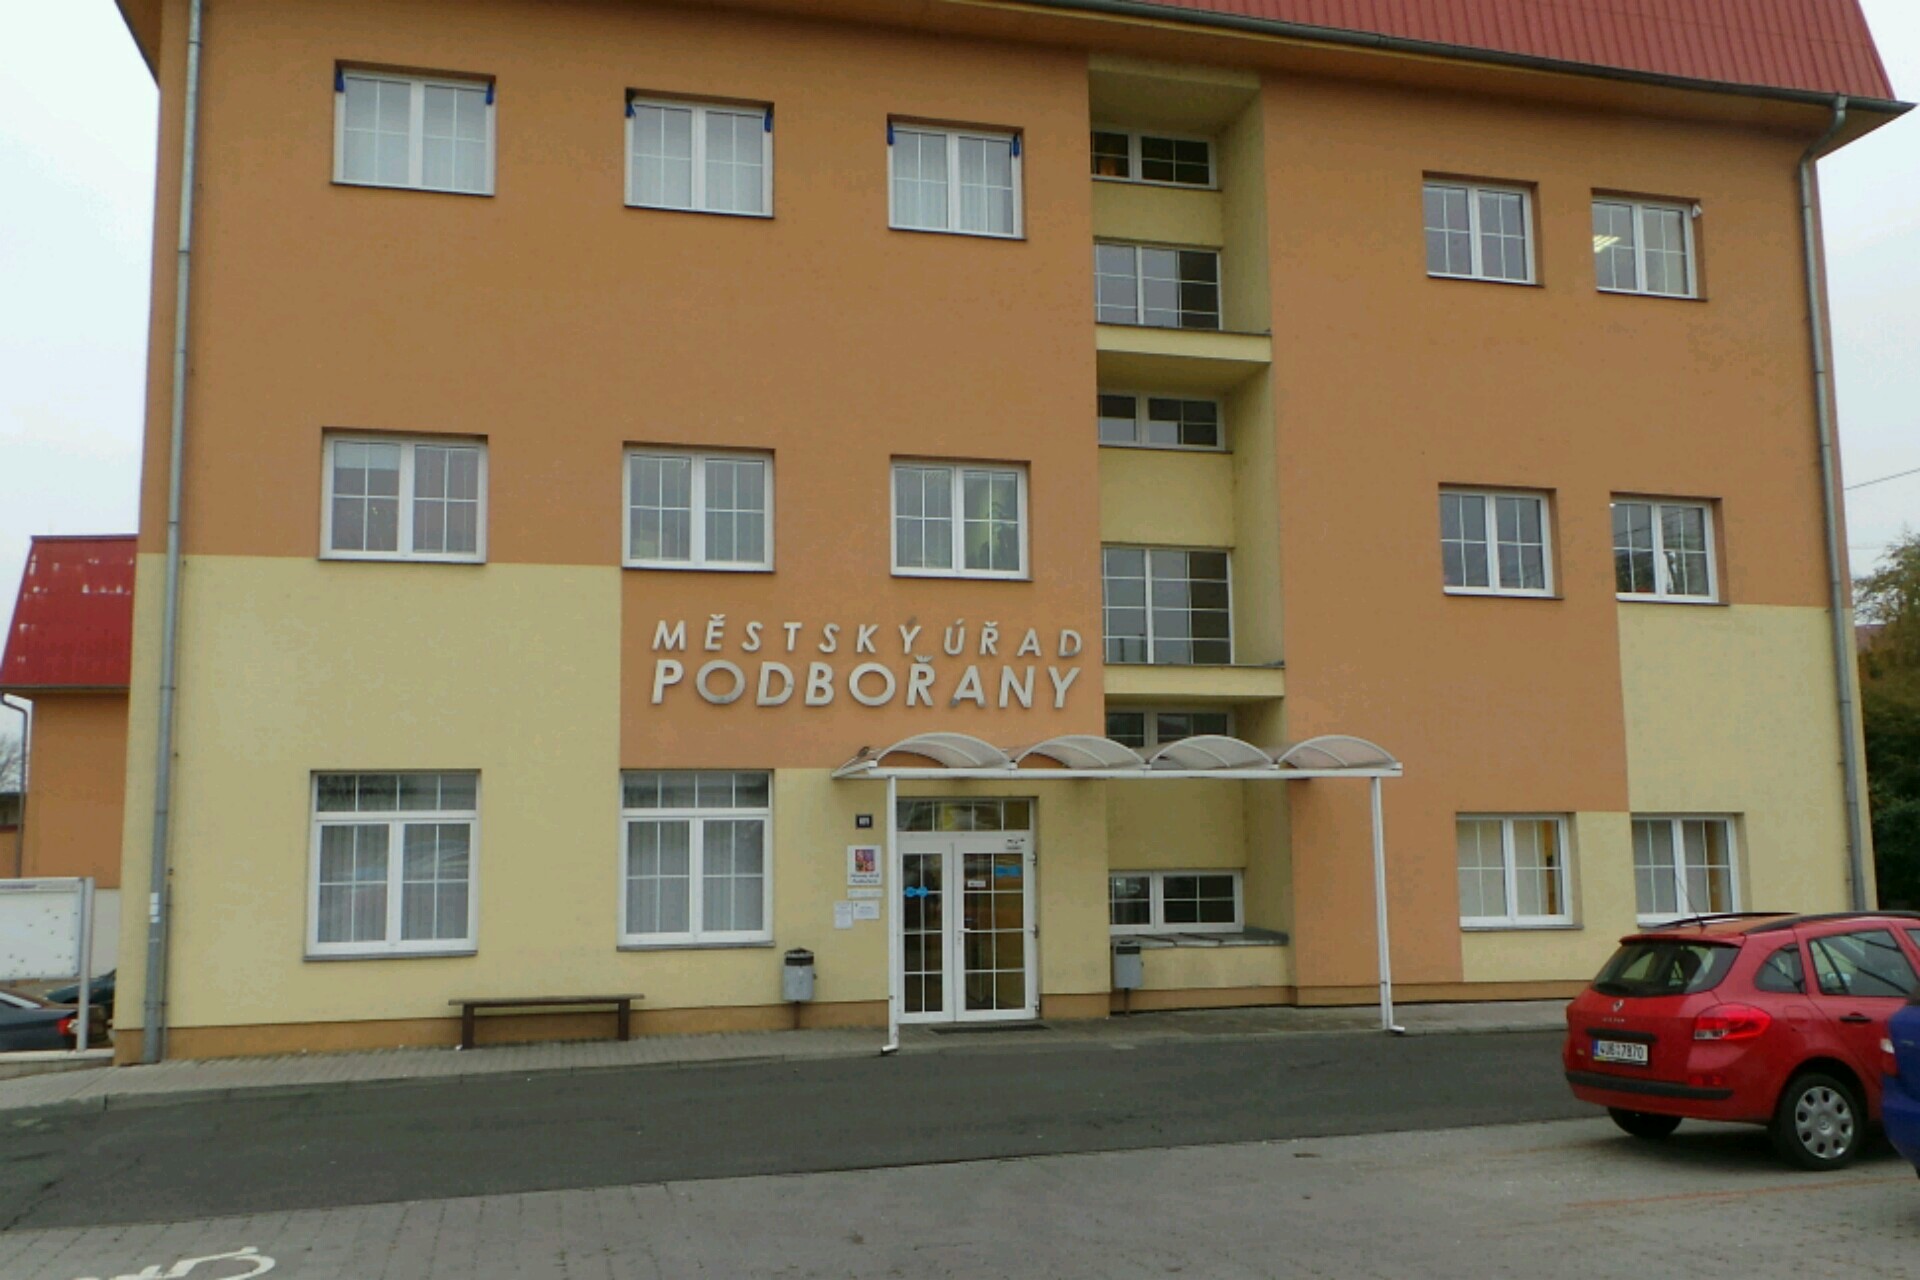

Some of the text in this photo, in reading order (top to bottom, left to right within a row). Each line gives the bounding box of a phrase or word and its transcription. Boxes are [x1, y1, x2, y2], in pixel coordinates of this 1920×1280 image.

[651, 614, 1083, 658] MĚSTSKÝ ÚŘAD
[651, 655, 1080, 709] PODBOŘANY
